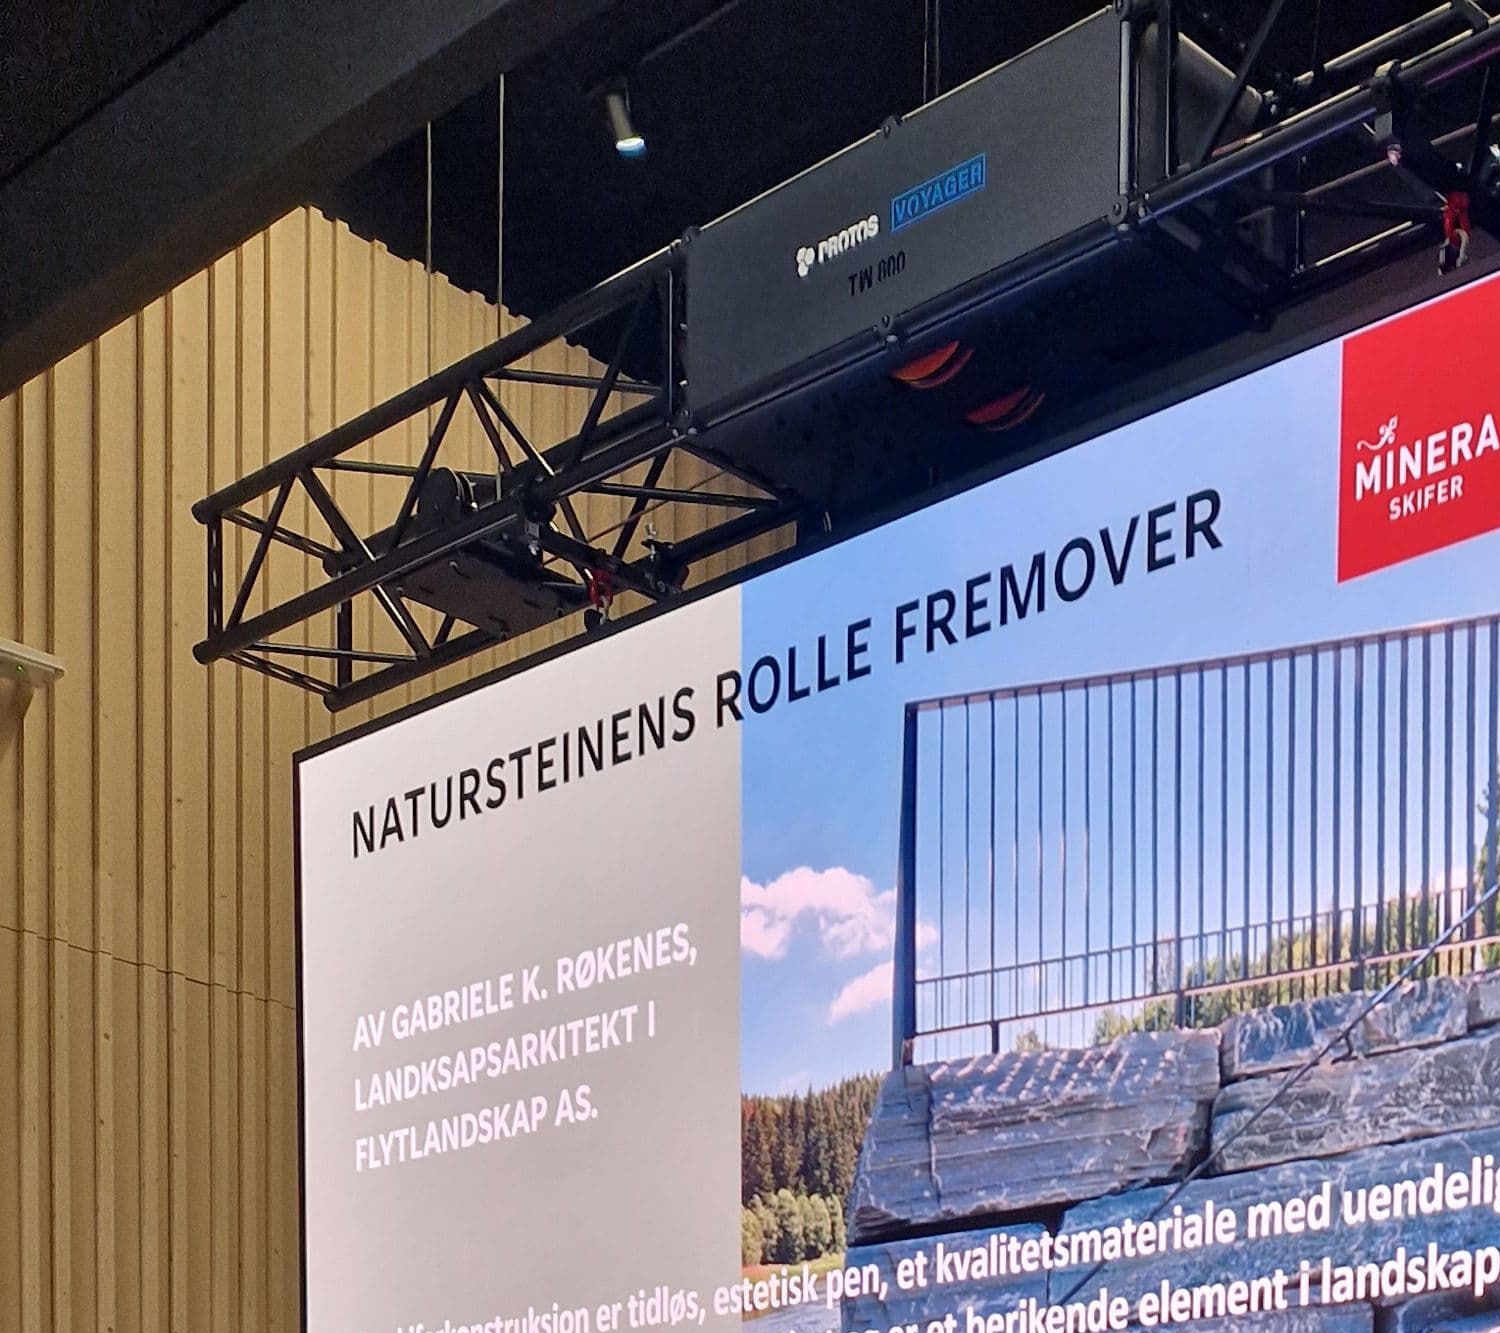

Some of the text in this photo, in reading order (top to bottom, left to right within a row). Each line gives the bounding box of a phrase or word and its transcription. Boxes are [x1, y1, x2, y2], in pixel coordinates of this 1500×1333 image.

[817, 161, 983, 264] PROTOS VOYAGER
[848, 265, 874, 297] TW
[1388, 474, 1465, 521] SKIFER
[352, 486, 1224, 859] NATURSTEINENS ROLLE FREMOVER
[353, 922, 698, 1052] AV GABRIELE K. RØKENES,
[354, 1000, 656, 1112] LANDKSAPSARKITEKT I
[355, 1084, 600, 1172] FLYTLANDSKAP AS.
[596, 1299, 623, 1331] er
[627, 1284, 707, 1328] tidløs,
[714, 1263, 820, 1317] estetisk
[826, 1260, 889, 1309] pen,
[896, 1251, 928, 1291] et
[935, 1201, 1237, 1284] kvalitetsmateriale
[1247, 1181, 1331, 1237] med
[1137, 1268, 1289, 1328] element
[1299, 1260, 1310, 1308] i
